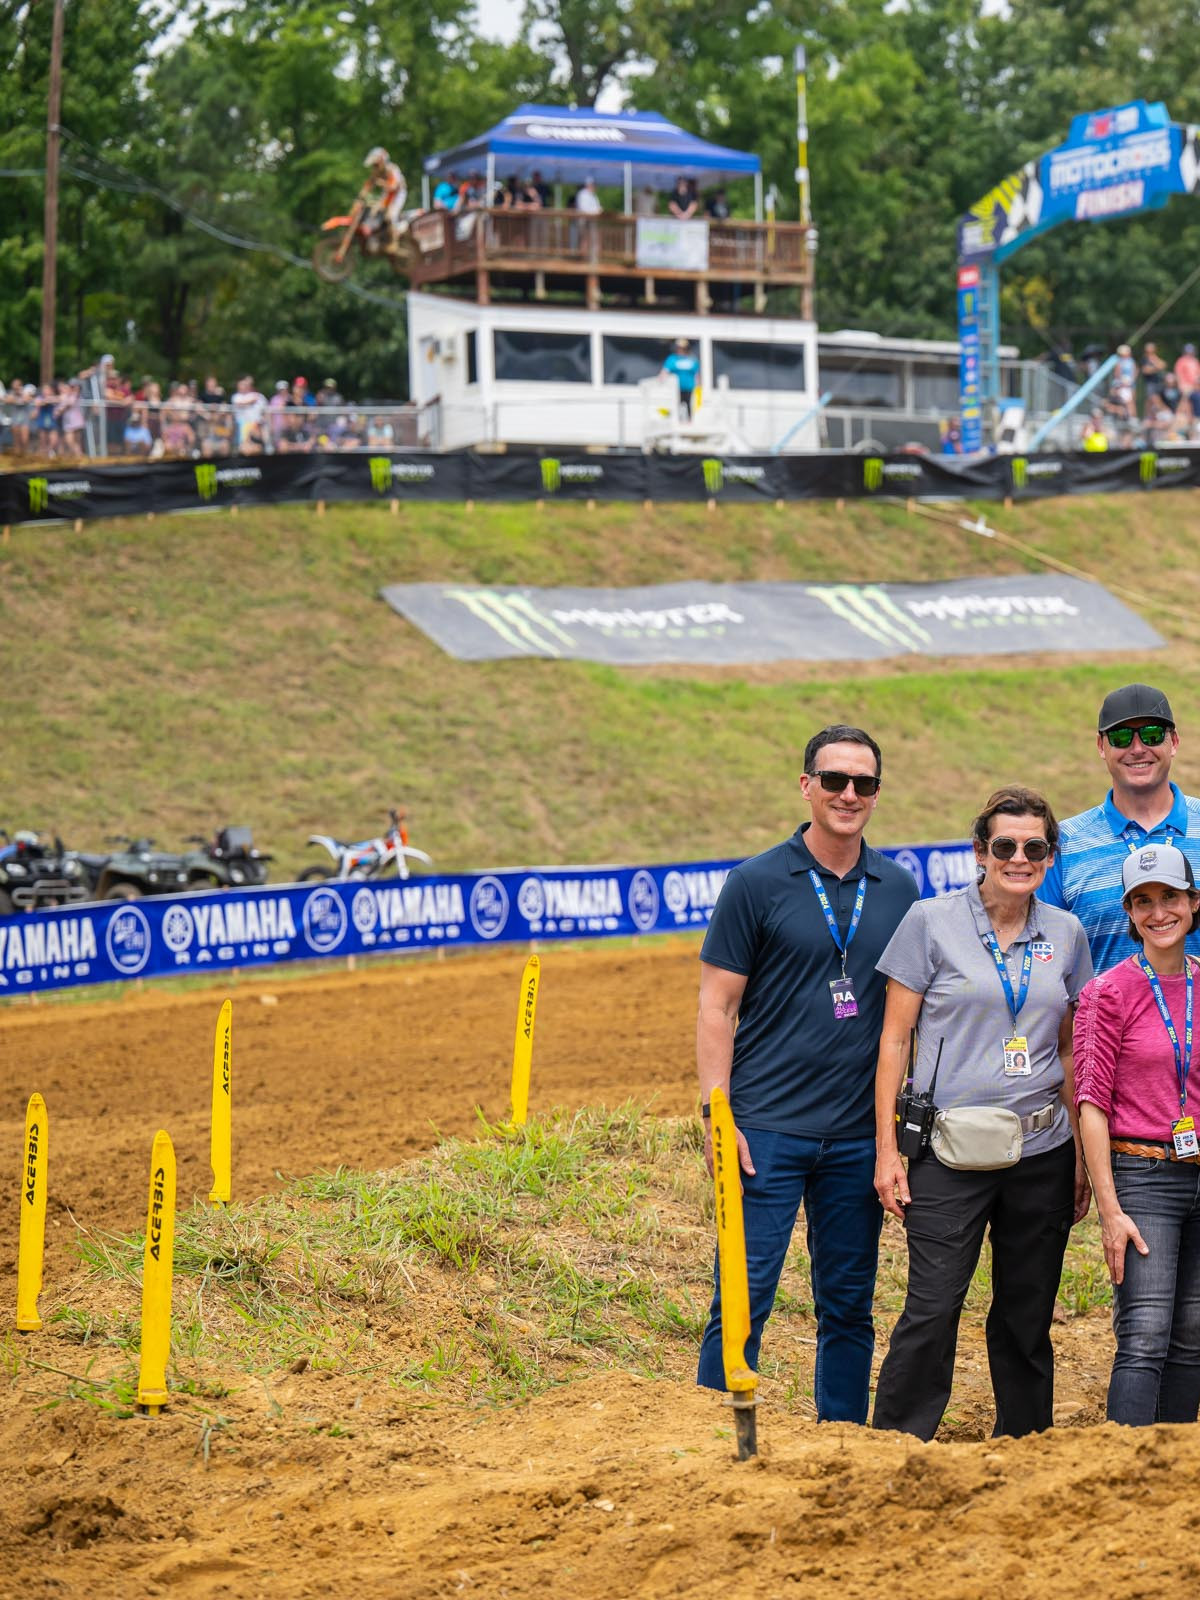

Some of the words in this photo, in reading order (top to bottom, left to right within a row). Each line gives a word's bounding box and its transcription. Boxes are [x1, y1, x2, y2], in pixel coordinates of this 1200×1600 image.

[375, 884, 466, 929] YAMAHA
[543, 878, 624, 918] YAMAHA
[191, 897, 297, 946] YAMAHA
[361, 924, 461, 946] RACING
[175, 940, 290, 965] RACING
[524, 978, 535, 1039] ACERBIS
[1167, 1026, 1177, 1043] 2024
[25, 1123, 39, 1206] ACERBIS
[150, 1167, 164, 1261] ACERBIS
